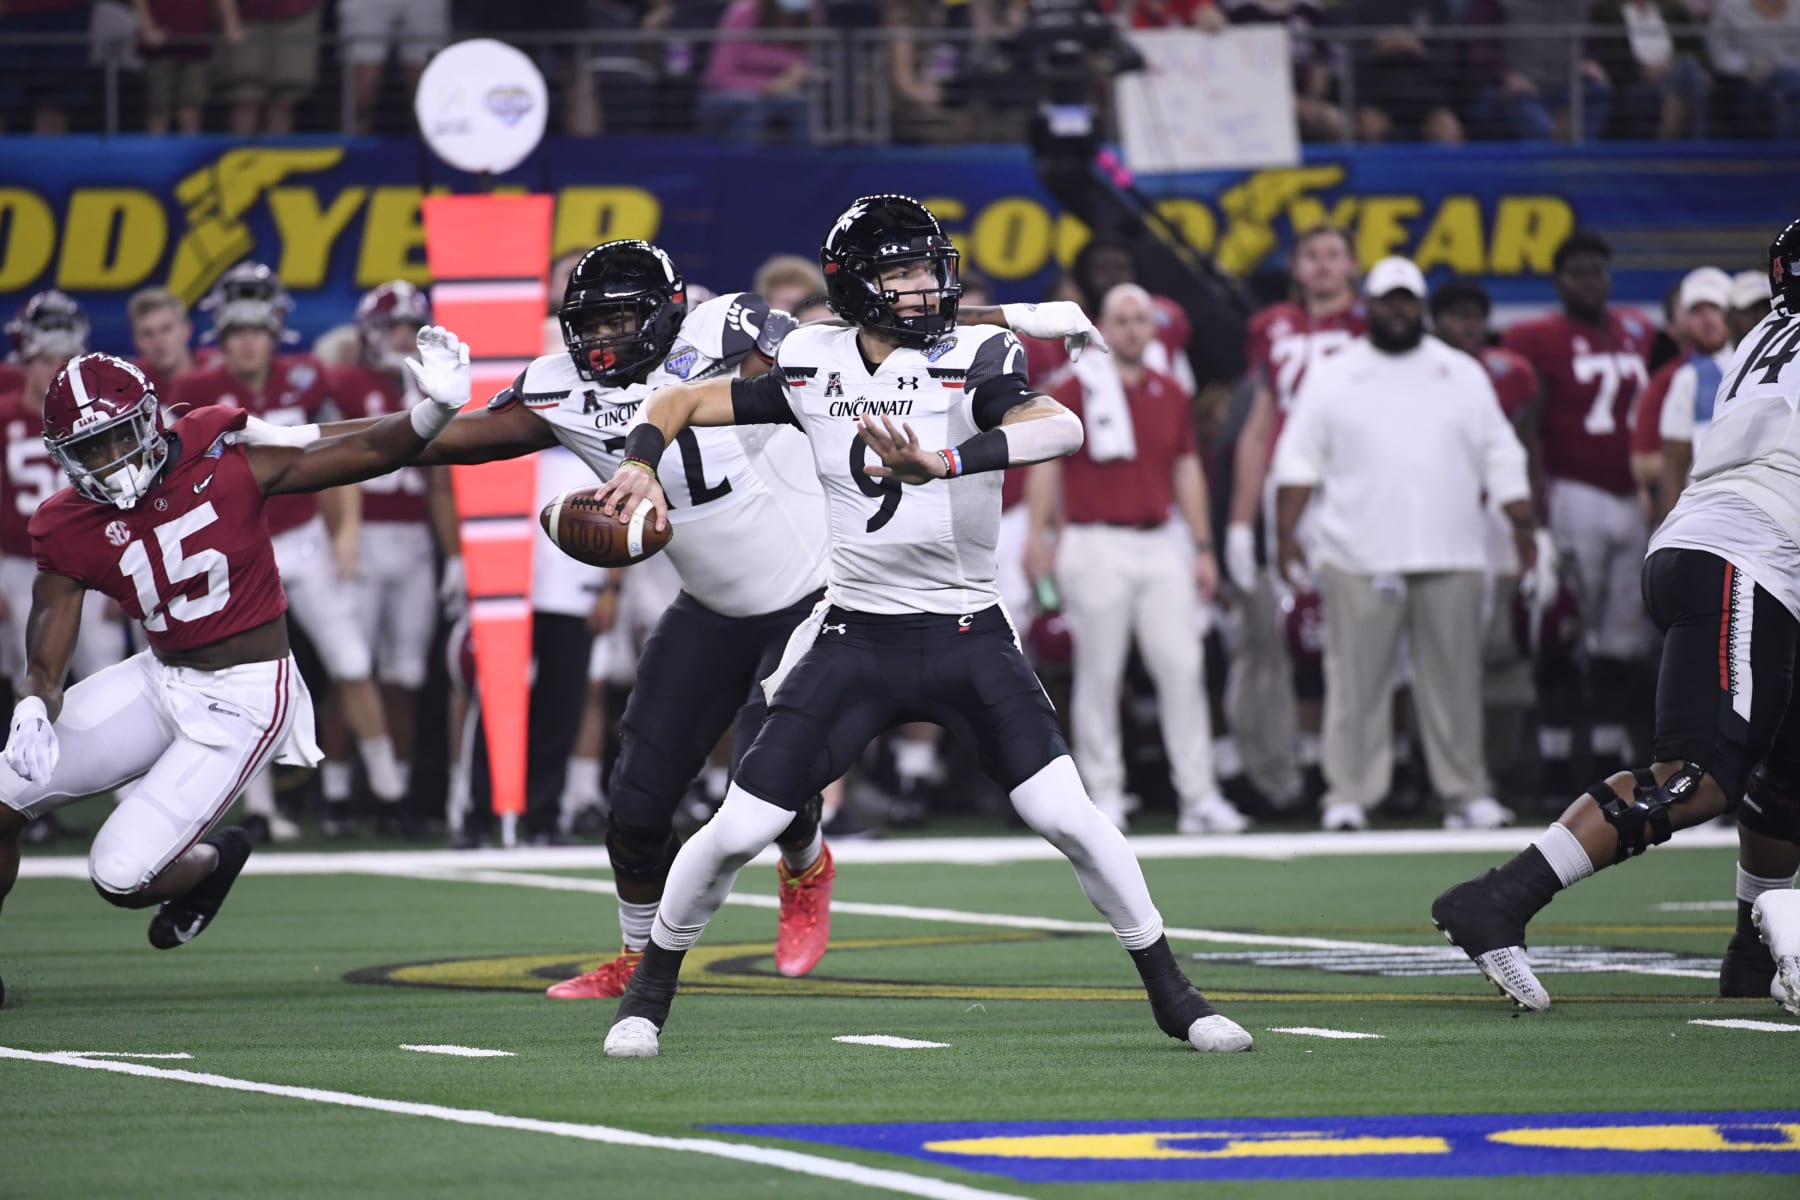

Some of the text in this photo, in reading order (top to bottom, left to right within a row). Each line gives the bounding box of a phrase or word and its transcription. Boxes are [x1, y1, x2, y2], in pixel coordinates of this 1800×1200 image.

[1572, 353, 1650, 434] 77
[1725, 316, 1800, 402] 14
[78, 415, 99, 428] BAMA
[829, 397, 913, 418] CINCINNATI
[849, 430, 903, 533] 9
[105, 520, 131, 546] SEC
[118, 500, 231, 632] 15
